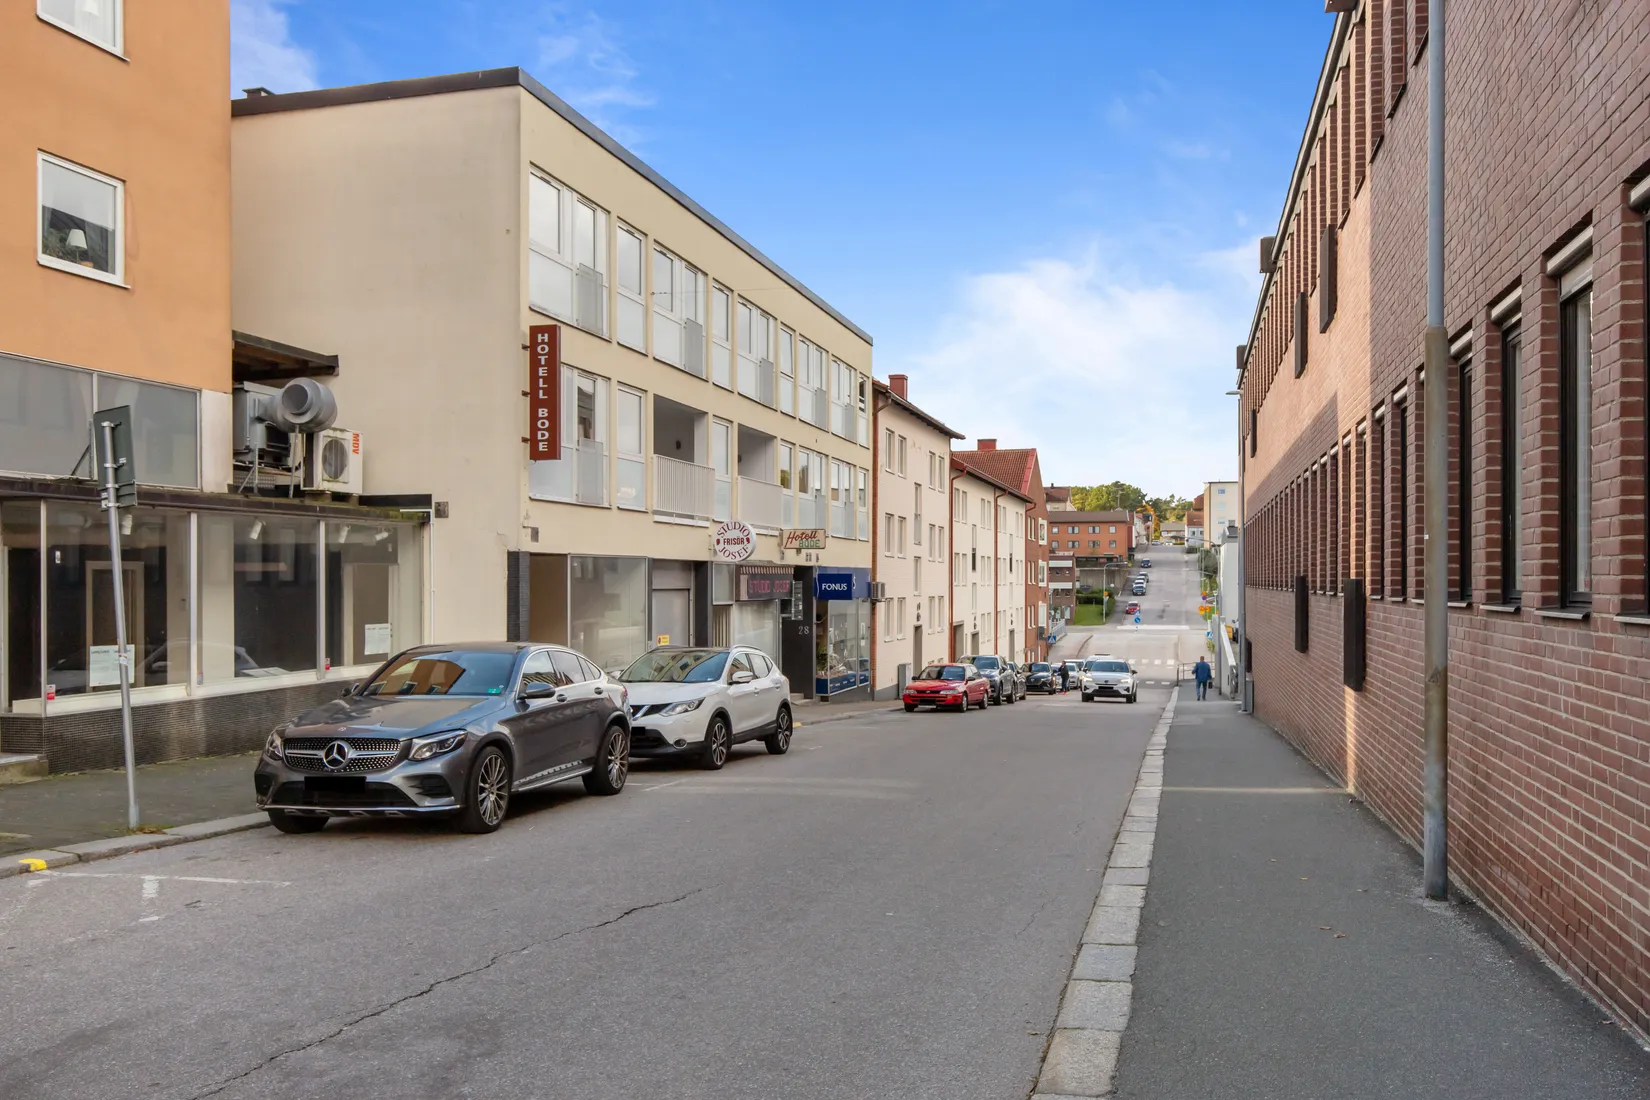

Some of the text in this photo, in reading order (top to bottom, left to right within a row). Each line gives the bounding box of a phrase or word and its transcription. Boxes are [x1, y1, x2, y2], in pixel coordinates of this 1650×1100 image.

[537, 333, 549, 451] HOTELL BODE
[352, 433, 360, 454] MDV
[717, 521, 750, 538] STUDIO
[723, 536, 745, 545] FRISÖR
[785, 530, 817, 548] Hotell
[799, 539, 820, 548] BODE
[718, 544, 749, 560] JOSEF
[821, 583, 848, 591] FONUS
[798, 625, 810, 635] 28
